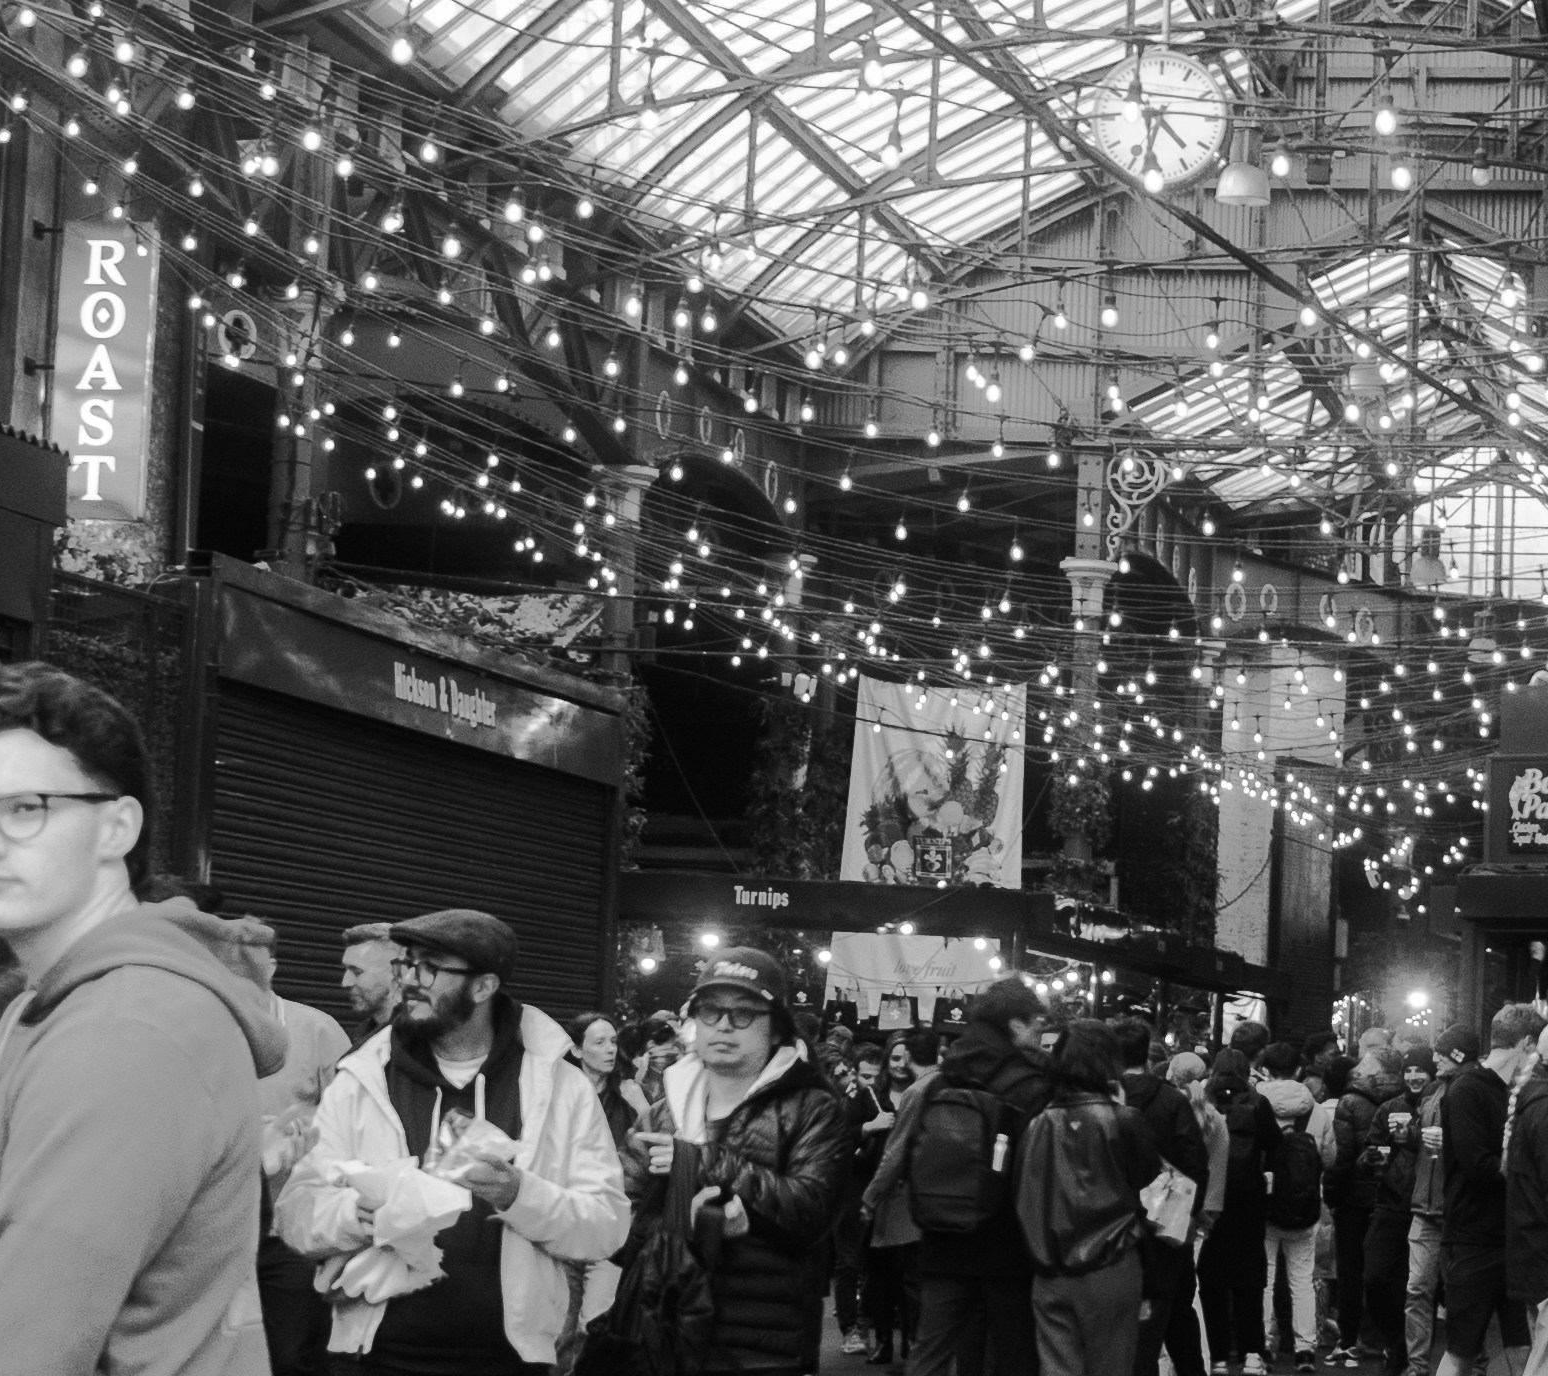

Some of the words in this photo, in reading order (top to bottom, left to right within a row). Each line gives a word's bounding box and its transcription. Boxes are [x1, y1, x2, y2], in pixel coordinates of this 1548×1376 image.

[72, 239, 127, 501] ROAST
[394, 661, 437, 709] Hickson
[439, 675, 449, 712] &
[450, 679, 496, 728] Daughter
[734, 885, 789, 909] Turnips
[919, 960, 958, 980] fruit
